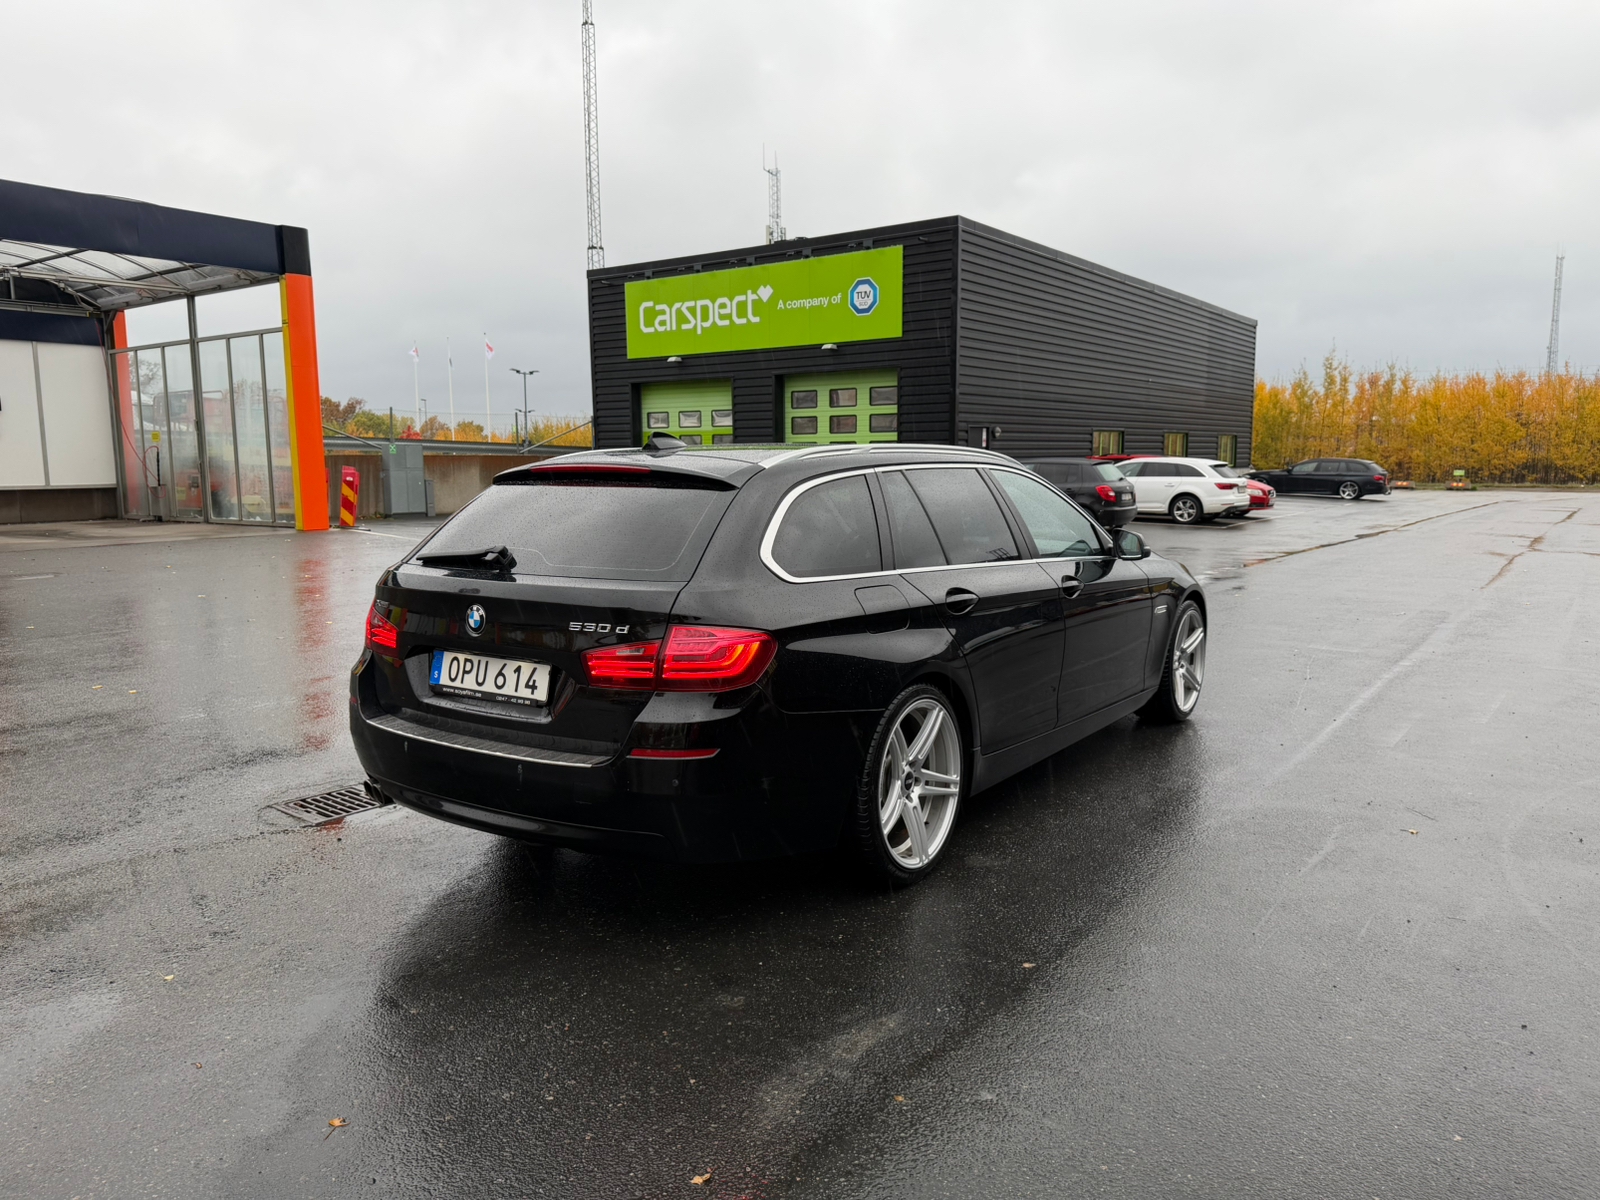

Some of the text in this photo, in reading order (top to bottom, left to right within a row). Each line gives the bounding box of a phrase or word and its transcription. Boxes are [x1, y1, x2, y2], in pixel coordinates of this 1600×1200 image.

[777, 293, 842, 310] A company of
[639, 289, 760, 335] Carspect
[568, 621, 630, 634] 530 d
[433, 670, 439, 679] S
[448, 656, 538, 695] OPU 614
